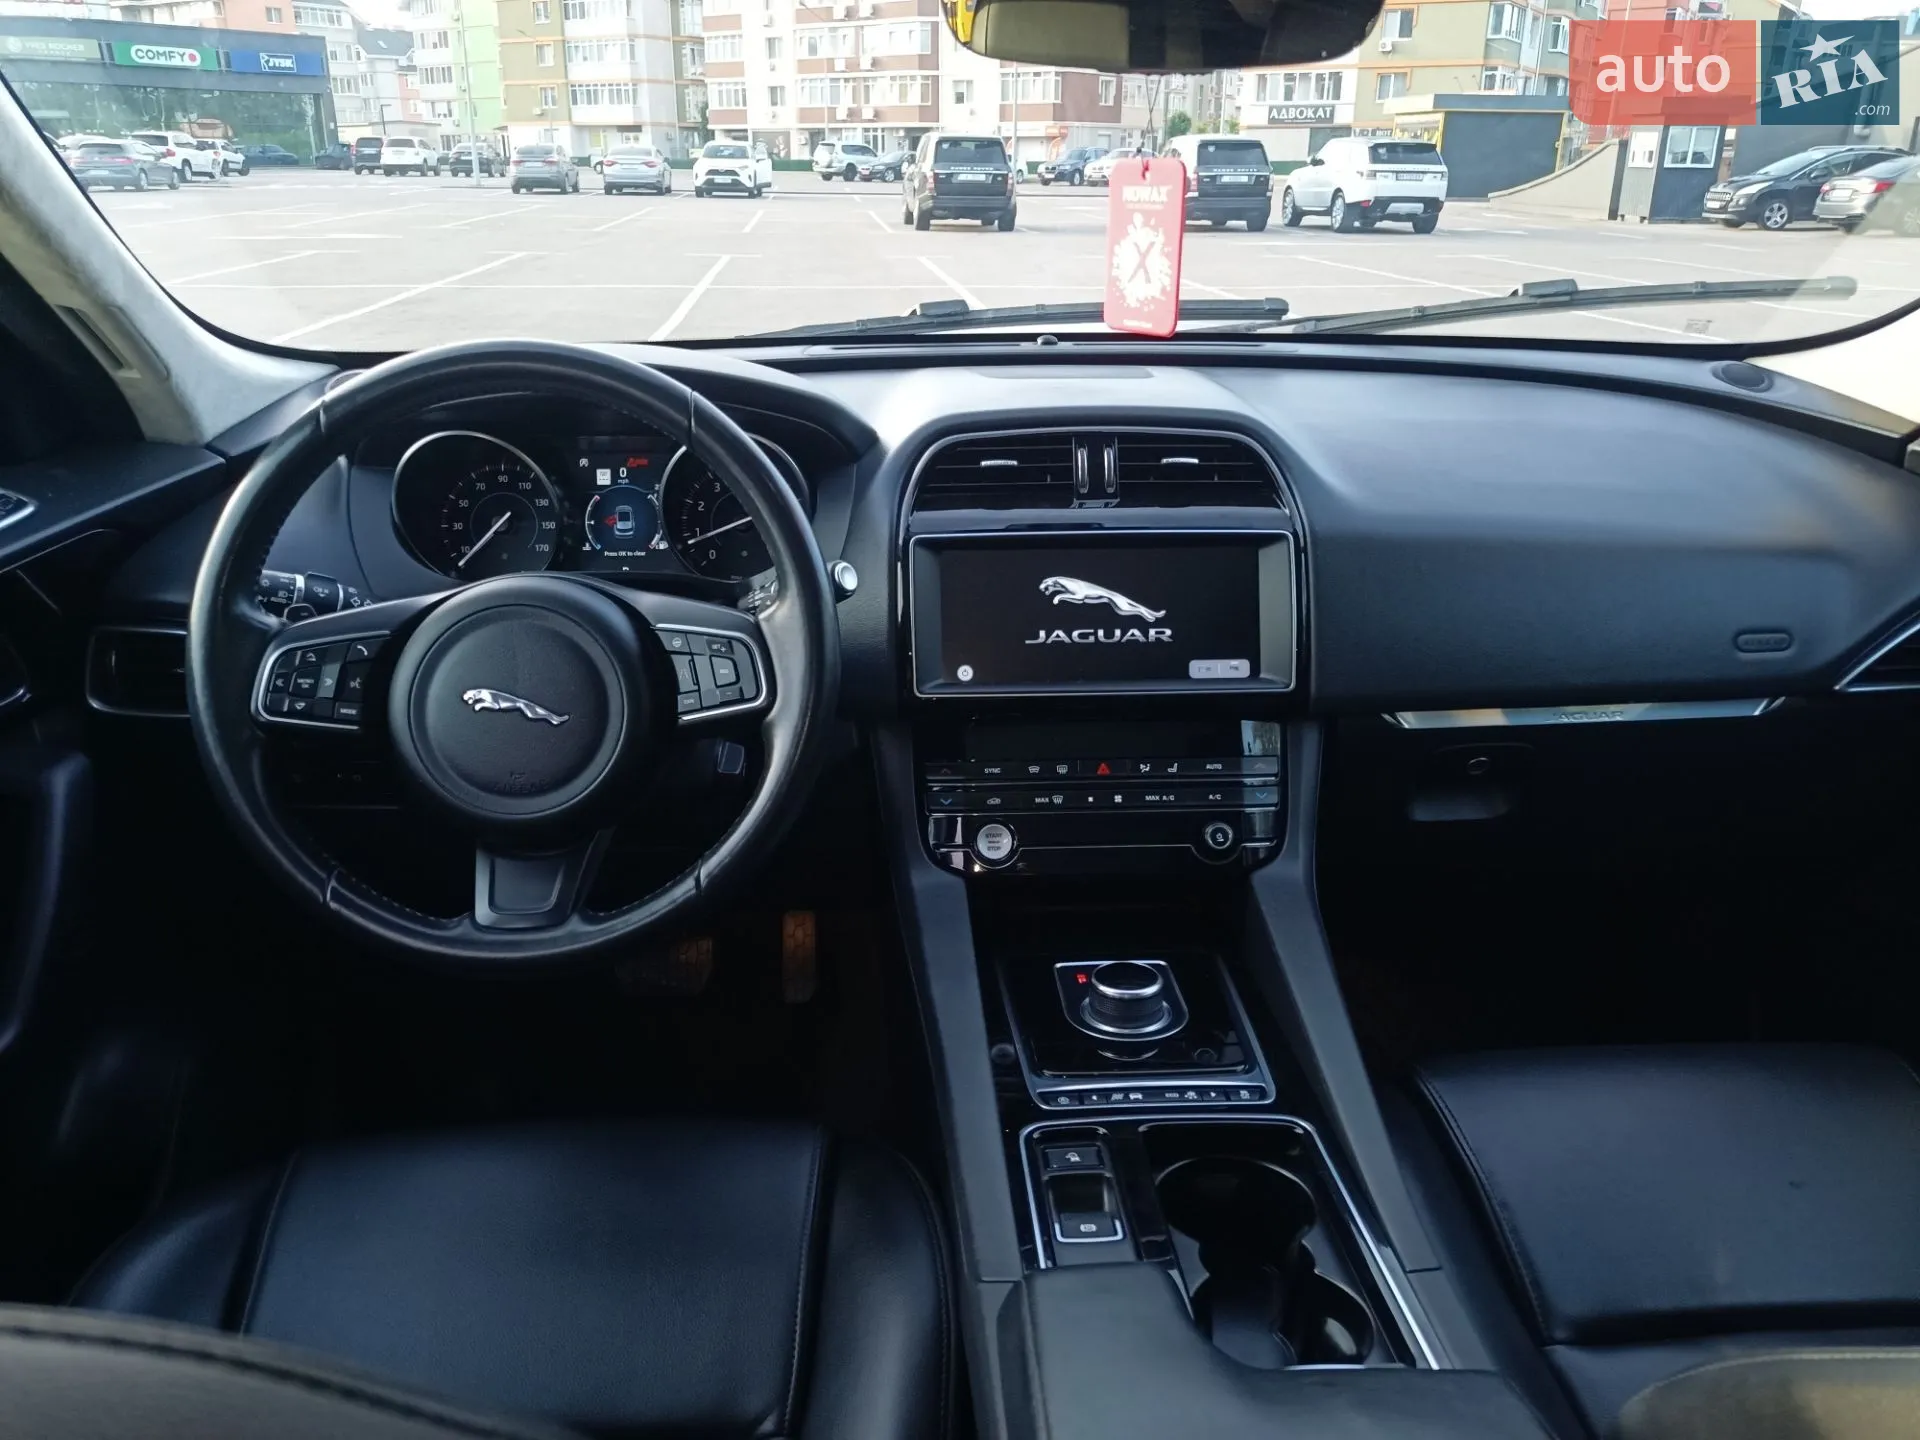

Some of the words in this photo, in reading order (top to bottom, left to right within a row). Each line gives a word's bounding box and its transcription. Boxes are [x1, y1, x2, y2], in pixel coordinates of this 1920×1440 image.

[134, 48, 186, 62] COMFY
[1269, 106, 1333, 120] АДВОКАТ
[619, 467, 627, 478] 0
[497, 475, 509, 483] 90
[475, 482, 486, 490] 70
[518, 482, 532, 490] 110
[713, 482, 721, 493] 3
[458, 499, 469, 507] 50
[535, 499, 549, 507] 130
[697, 501, 705, 511] 2
[452, 522, 464, 530] 30
[541, 521, 556, 529] 150
[535, 544, 549, 552] 170
[708, 549, 716, 560] 0
[1025, 628, 1173, 644] JAGUAR
